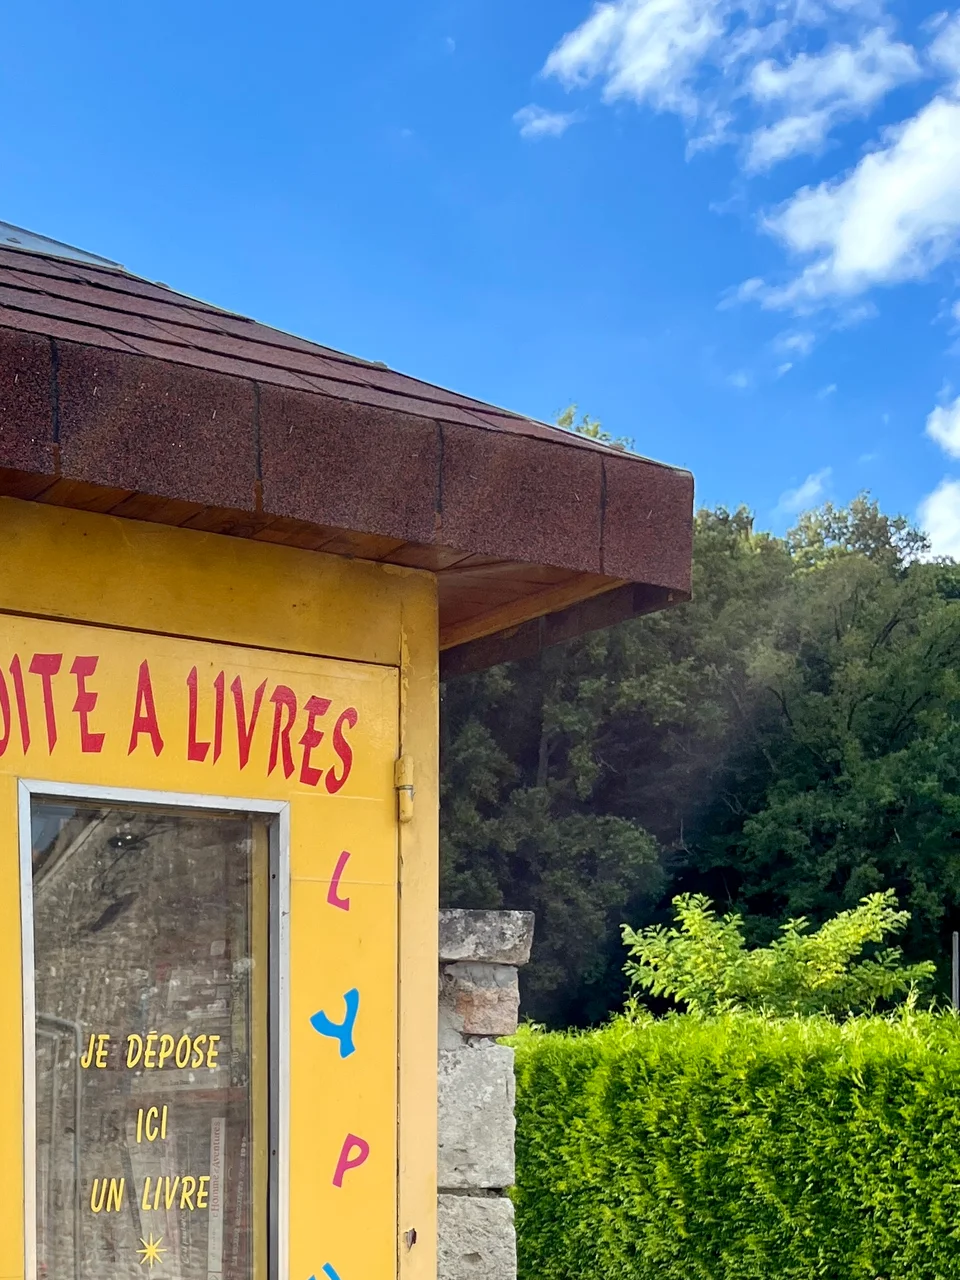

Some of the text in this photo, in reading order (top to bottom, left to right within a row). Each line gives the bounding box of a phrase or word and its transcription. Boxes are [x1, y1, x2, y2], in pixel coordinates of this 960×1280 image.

[128, 658, 164, 756] A
[186, 665, 358, 794] LIVRES
[309, 987, 360, 1059] Y
[80, 1033, 110, 1069] JE
[126, 1030, 221, 1069] DÉPOSE
[136, 1105, 168, 1143] ICI
[332, 1133, 370, 1188] P
[90, 1176, 210, 1213] UN LIVRE
